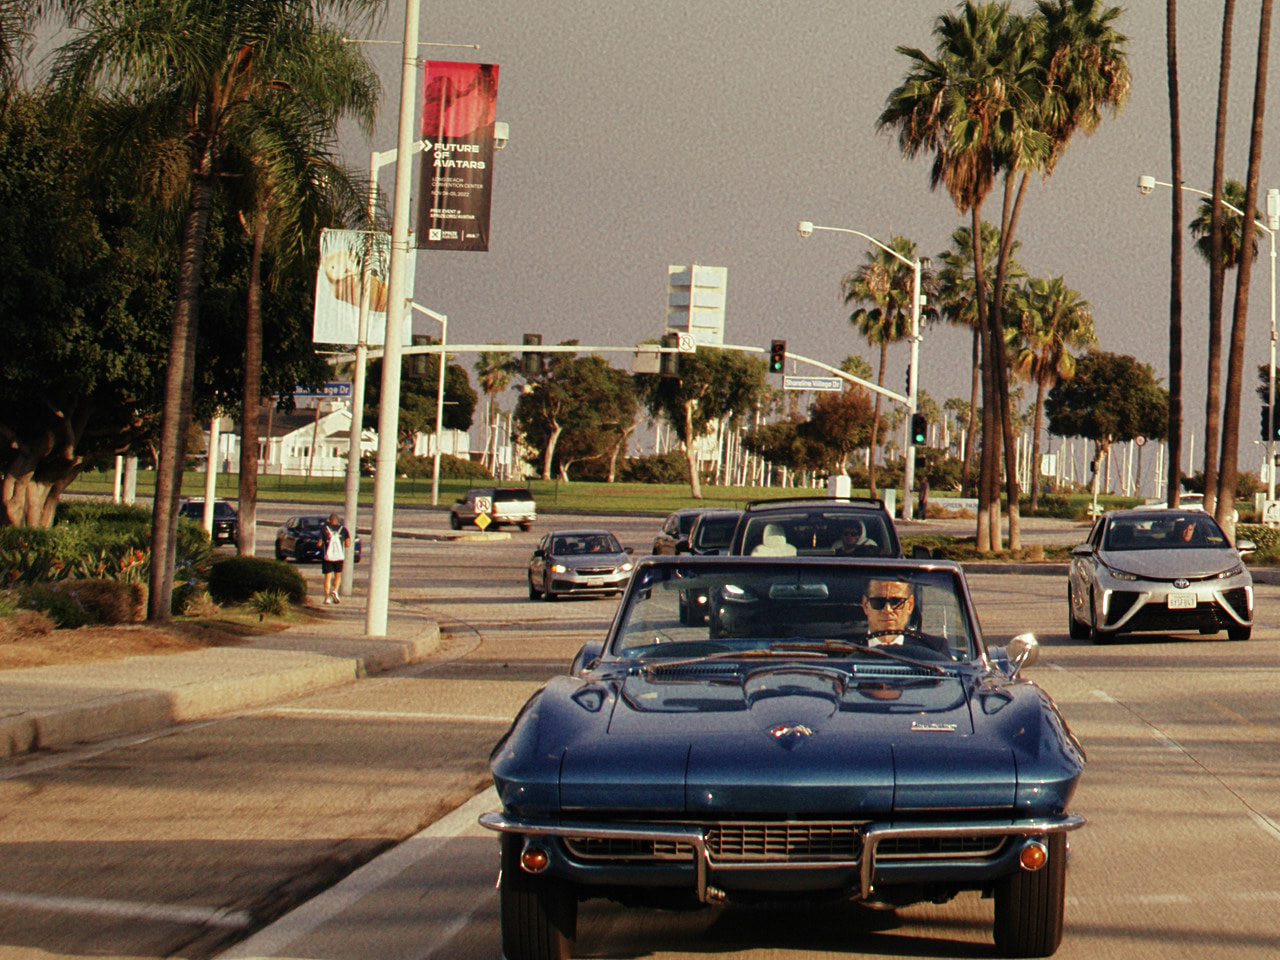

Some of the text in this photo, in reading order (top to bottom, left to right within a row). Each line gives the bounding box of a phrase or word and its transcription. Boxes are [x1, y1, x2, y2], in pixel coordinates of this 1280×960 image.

[433, 143, 480, 152] FUTURE
[433, 151, 450, 159] OF
[433, 159, 486, 169] AVATARS
[339, 385, 349, 394] Dr
